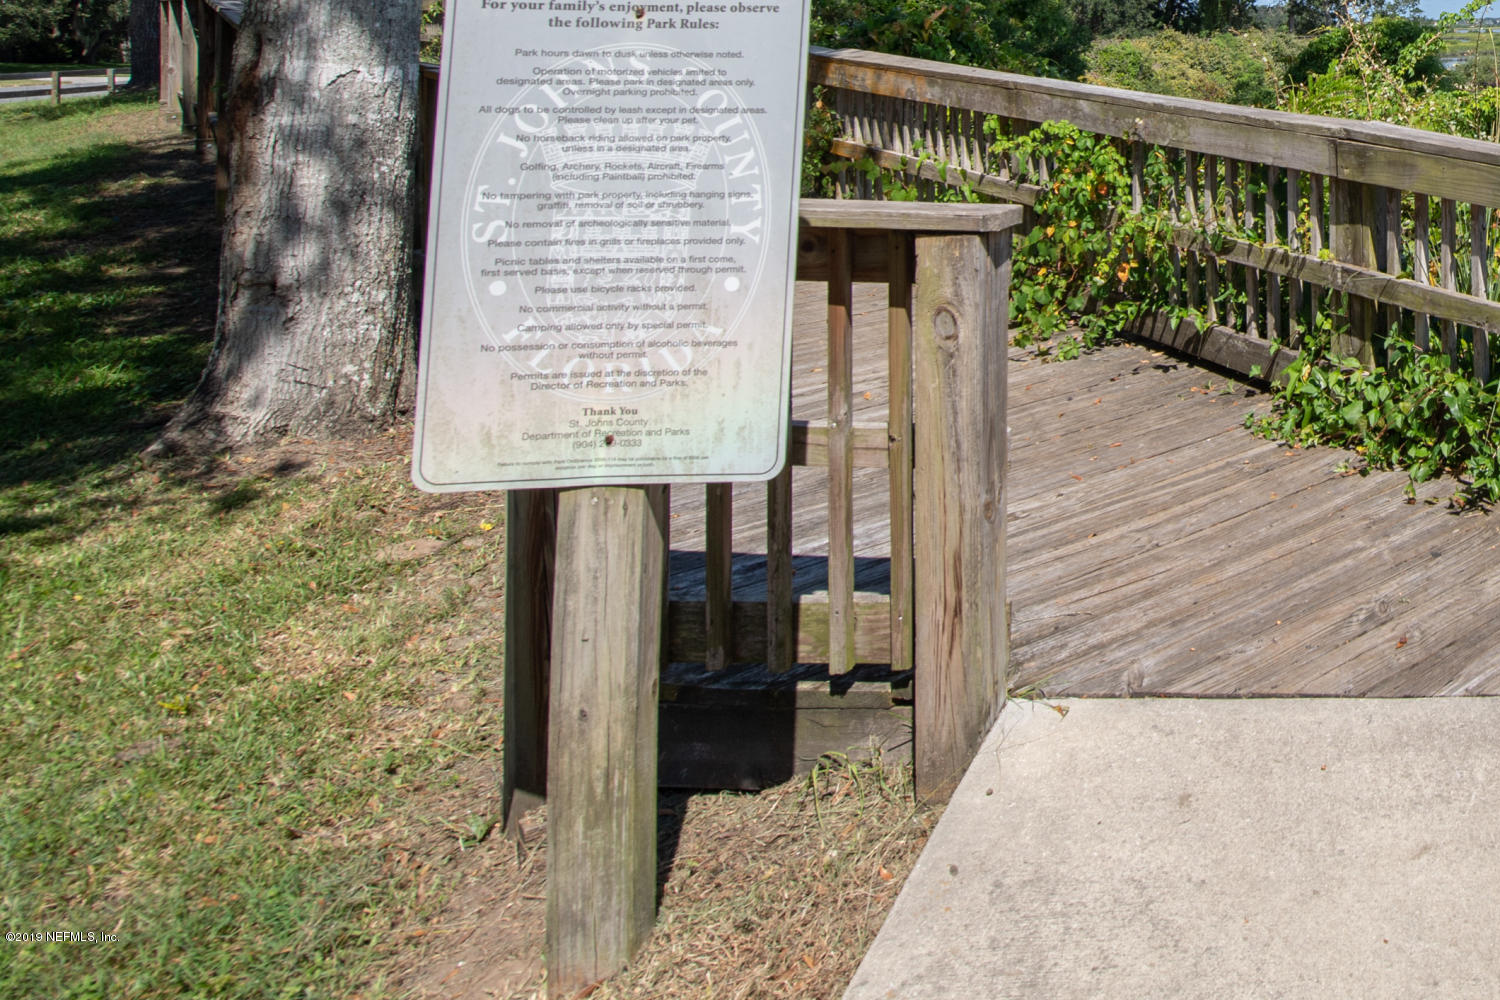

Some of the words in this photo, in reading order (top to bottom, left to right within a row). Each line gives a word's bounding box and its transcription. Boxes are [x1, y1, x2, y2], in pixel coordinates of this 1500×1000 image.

[482, 0, 506, 10] For
[511, 3, 544, 13] your
[549, 0, 605, 13] family’s
[609, 1, 683, 14] enjoyment,
[687, 1, 726, 15] please
[730, 2, 779, 13] observe
[549, 17, 571, 28] the
[576, 18, 642, 31] following
[647, 18, 676, 29] Park
[680, 19, 719, 29] Rules:
[515, 49, 537, 57] Park
[541, 49, 569, 57] hours
[572, 49, 599, 57] dawn
[716, 50, 743, 58] noted.
[532, 68, 582, 77] Operation
[496, 77, 552, 87] designated
[589, 77, 621, 85] Please
[624, 78, 643, 87] park
[657, 78, 705, 87] designated
[735, 78, 755, 88] only.
[563, 88, 610, 97] Overnight
[613, 88, 647, 97] parking
[495, 106, 520, 115] dogs
[605, 106, 615, 115] by
[646, 106, 676, 115] except
[689, 106, 738, 115] designated
[558, 116, 590, 124] Please
[594, 116, 618, 124] clean
[622, 118, 633, 126] up
[637, 116, 656, 124] after
[682, 116, 698, 125] pet.
[589, 134, 615, 144] riding
[618, 134, 653, 142] allowed
[670, 134, 690, 144] park
[693, 134, 731, 144] property,
[520, 163, 559, 173] Golfing,
[563, 163, 599, 173] Archery,
[604, 163, 643, 172] Rockets,
[648, 162, 682, 171] Aircraft,
[648, 172, 695, 182] prohibited.
[482, 191, 496, 199] No
[500, 191, 550, 201] tampering
[554, 191, 575, 199] with
[578, 191, 598, 201] park
[602, 191, 642, 200] property,
[690, 190, 724, 200] hanging
[472, 178, 516, 243] ST.
[615, 201, 624, 209] of
[658, 201, 704, 210] shrubbery.
[505, 220, 519, 228] No
[522, 220, 562, 228] removal
[566, 220, 575, 228] of
[578, 219, 647, 229] archeologically
[651, 219, 691, 227] sensitive
[693, 219, 730, 227] material.
[488, 239, 522, 247] Please
[525, 239, 562, 247] contain
[637, 238, 680, 248] fireplaces
[684, 237, 723, 247] provided
[726, 237, 745, 247] only.
[495, 258, 525, 266] Picnic
[529, 257, 559, 265] tables
[562, 257, 581, 265] and
[584, 257, 621, 265] shelters
[624, 256, 664, 264] available
[481, 268, 501, 276] first
[504, 268, 537, 276] served
[573, 267, 605, 277] except
[608, 267, 632, 275] when
[636, 266, 676, 274] reserved
[678, 266, 712, 276] through
[715, 265, 745, 275] permit.
[535, 286, 567, 294] Please
[592, 285, 624, 295] bicycle
[519, 305, 533, 313] No
[633, 303, 666, 311] without
[677, 303, 708, 312] permit.
[517, 323, 562, 333] Camping
[565, 322, 602, 330] allowed
[605, 322, 624, 332] only
[628, 322, 638, 331] by
[642, 321, 674, 331] special
[480, 344, 495, 352] No
[498, 343, 555, 353] possession
[571, 341, 633, 352] consumption
[691, 339, 737, 349] beverages
[579, 351, 613, 359] without
[617, 350, 647, 360] permit.
[511, 371, 549, 380] Permits
[570, 370, 601, 379] issued
[605, 370, 614, 378] at
[617, 370, 631, 378] the
[634, 369, 679, 377] discretion
[694, 368, 708, 376] the
[531, 382, 570, 391] Director
[586, 380, 636, 389] Recreation
[640, 380, 656, 388] and
[582, 407, 616, 416] Thank
[620, 407, 638, 415] You
[585, 419, 613, 428] Johns
[616, 419, 648, 429] County
[522, 431, 579, 442] Department
[581, 431, 591, 439] of
[594, 429, 642, 438] Recreation
[645, 429, 662, 437] and
[665, 428, 689, 436] Parks
